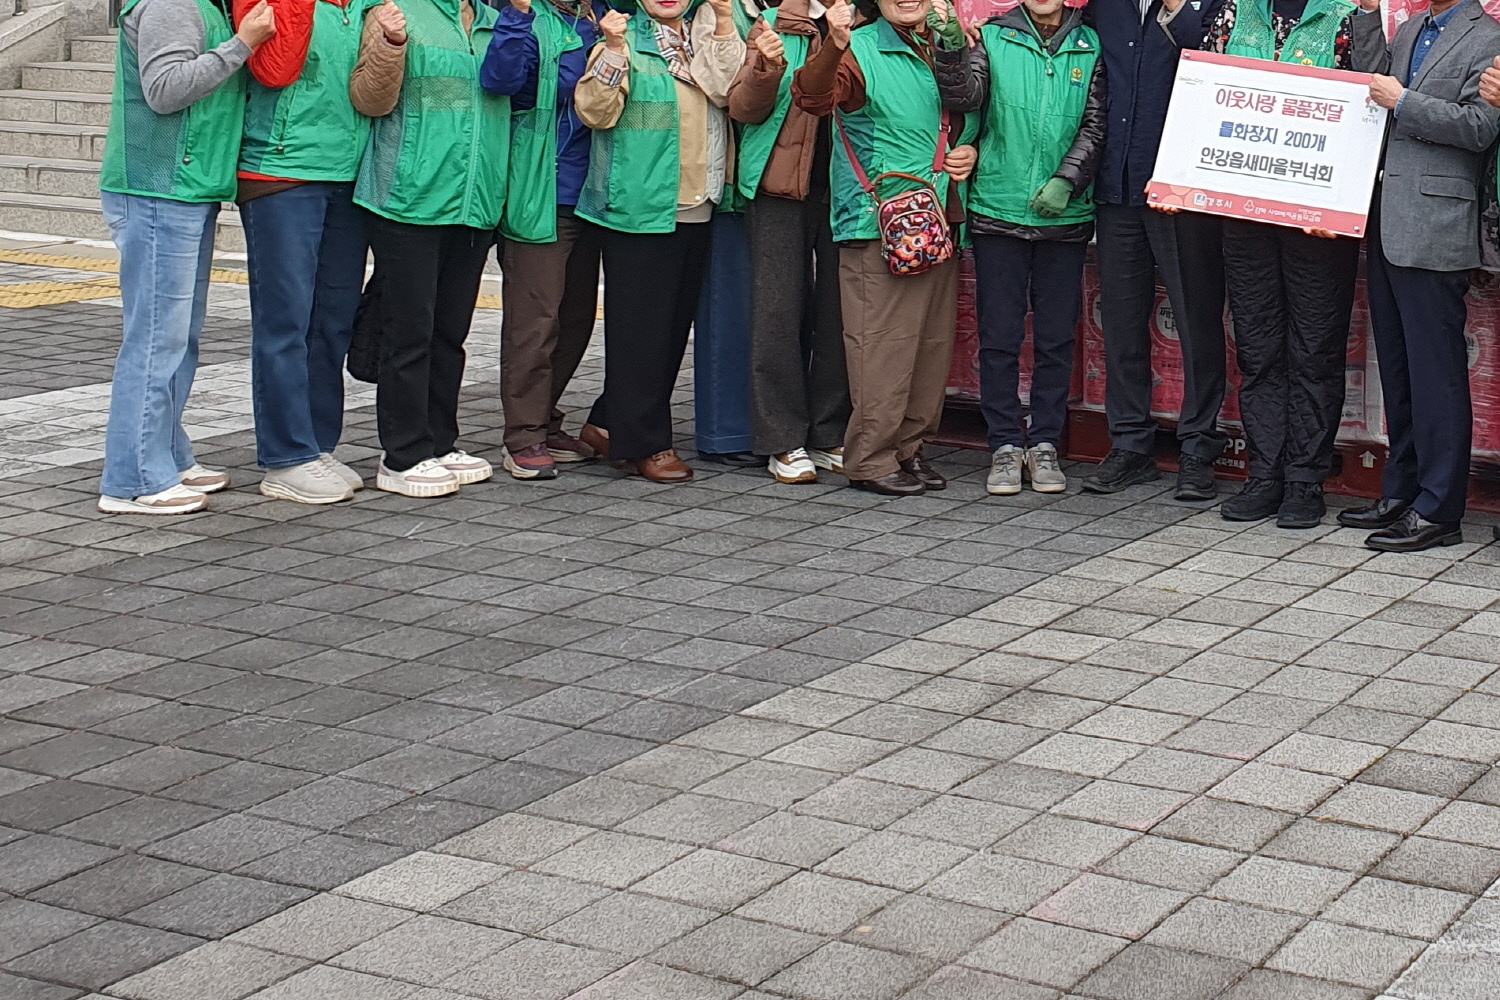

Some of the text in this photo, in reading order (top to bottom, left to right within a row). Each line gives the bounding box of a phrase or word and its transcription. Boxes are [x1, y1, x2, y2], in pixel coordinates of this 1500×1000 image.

[1215, 88, 1344, 123] 이웃사랑 물품전달
[1283, 130, 1327, 152] 200개
[1200, 146, 1334, 183] 안강읍새마을부녀회
[1223, 438, 1246, 455] PP
